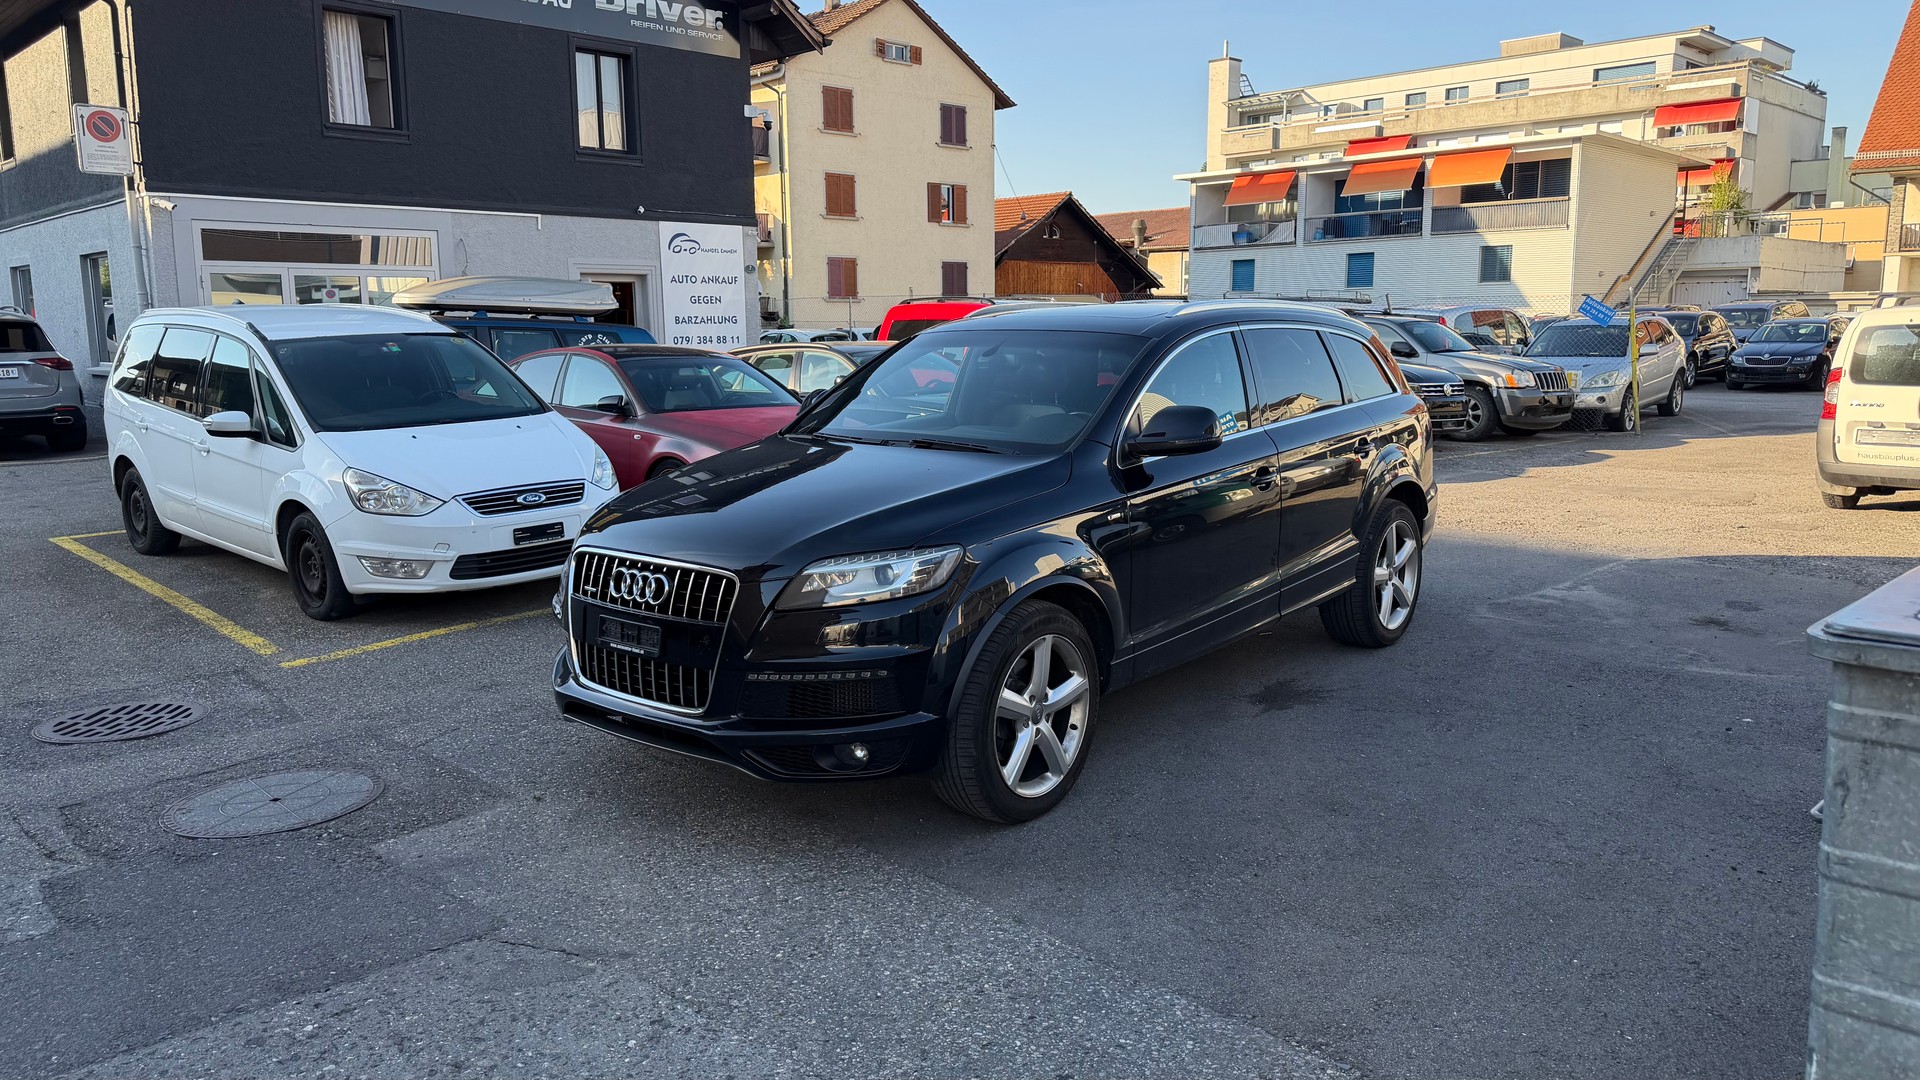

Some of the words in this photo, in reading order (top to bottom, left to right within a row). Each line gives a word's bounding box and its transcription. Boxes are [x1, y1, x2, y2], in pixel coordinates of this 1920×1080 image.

[630, 20, 664, 31] REIFEN
[665, 26, 686, 35] UND
[687, 29, 724, 41] SERVICE
[670, 275, 698, 284] AUTO
[700, 276, 738, 285] ANKAUF
[689, 295, 722, 304] GEGEN
[674, 315, 738, 325] BARZAHLUNG
[673, 336, 694, 345] 079/
[696, 335, 713, 345] 384
[716, 335, 727, 344] 88
[731, 335, 741, 344] 11
